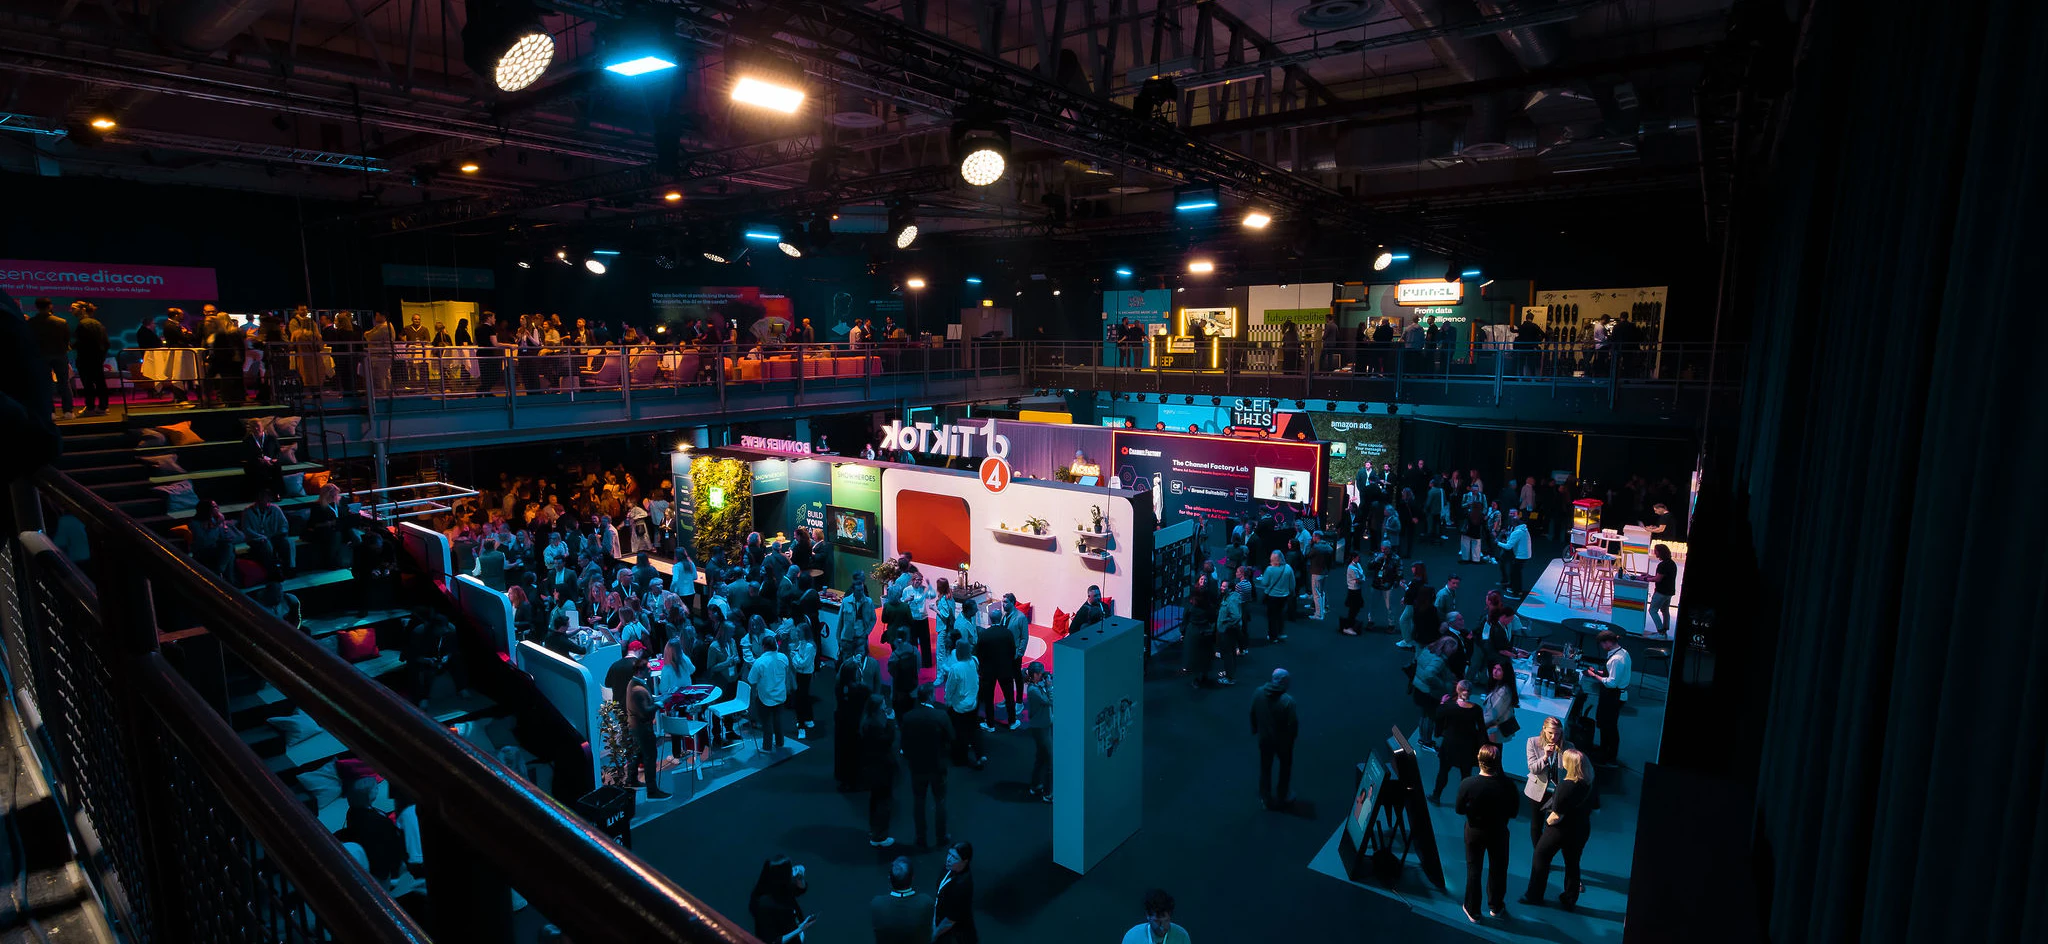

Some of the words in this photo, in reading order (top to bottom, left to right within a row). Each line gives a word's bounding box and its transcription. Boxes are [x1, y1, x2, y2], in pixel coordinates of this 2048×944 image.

[1294, 311, 1325, 322] realitie
[1234, 412, 1272, 426] THIS
[1331, 421, 1358, 431] amazon
[1359, 421, 1373, 430] ads
[1172, 459, 1184, 467] The
[1185, 461, 1209, 469] Channel
[1210, 463, 1235, 473] Factory
[1236, 464, 1249, 473] Lab
[985, 462, 1001, 489] 4
[807, 510, 823, 519] BUILD
[806, 518, 824, 528] YOUR
[607, 811, 625, 828] LIVE
